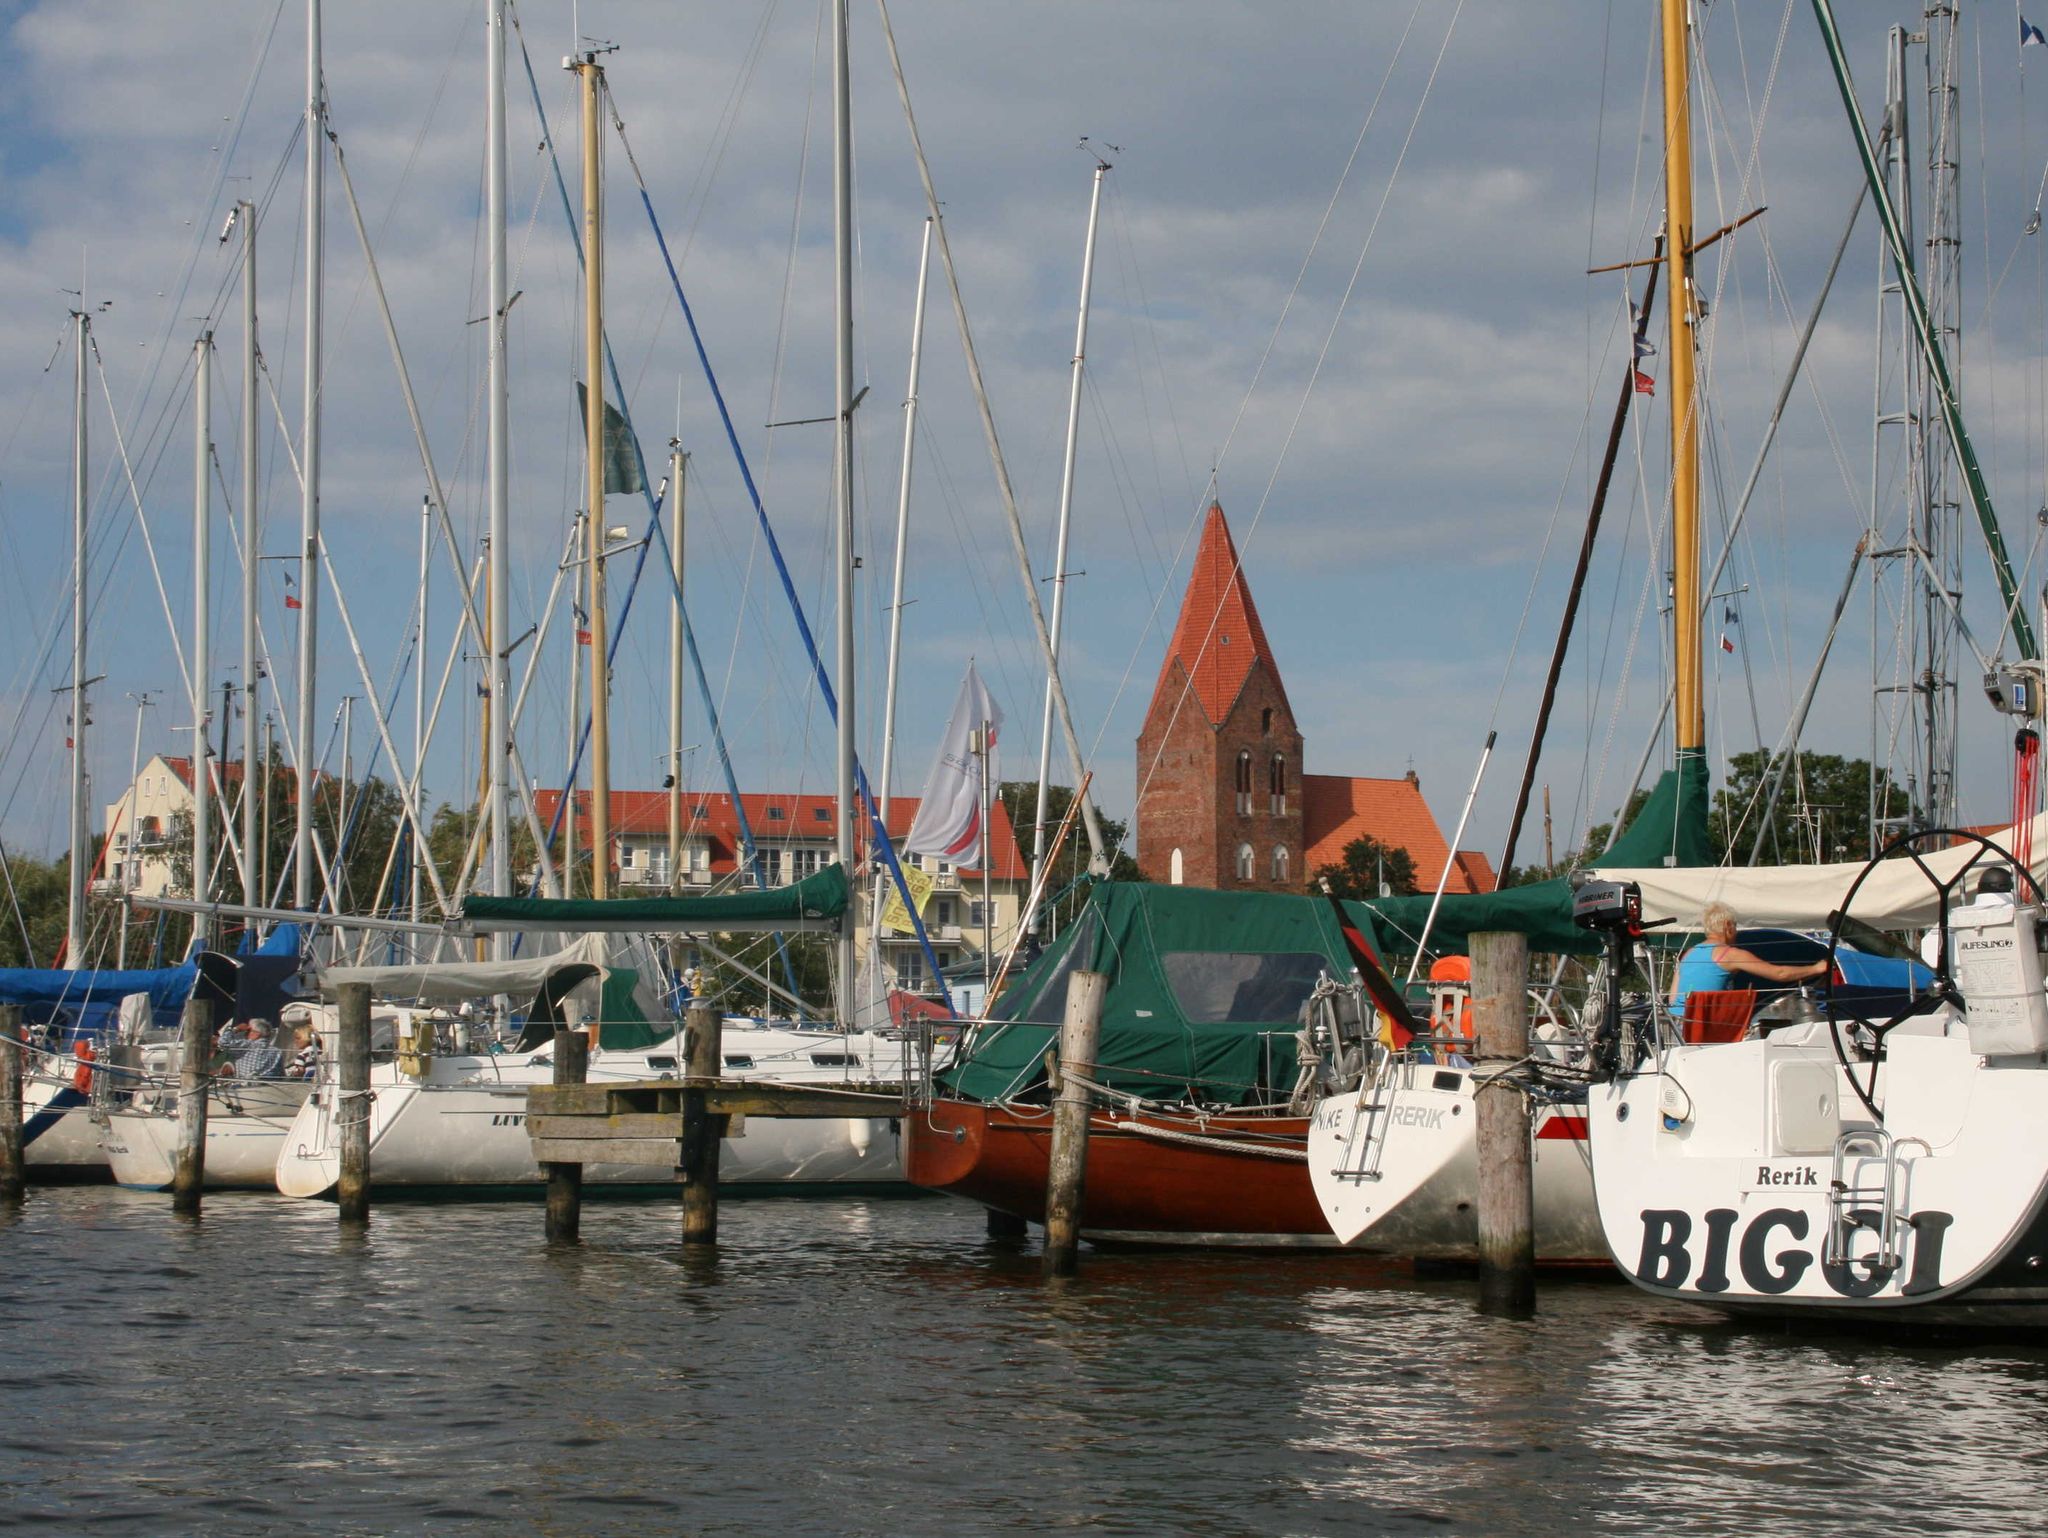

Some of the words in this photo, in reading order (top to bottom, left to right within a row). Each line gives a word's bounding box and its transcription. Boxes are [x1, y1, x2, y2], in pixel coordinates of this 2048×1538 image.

[492, 1115, 527, 1127] LUV
[1391, 1105, 1446, 1129] RERIK
[1756, 1166, 1818, 1186] Rerik
[1636, 1207, 1954, 1298] BIGGI
